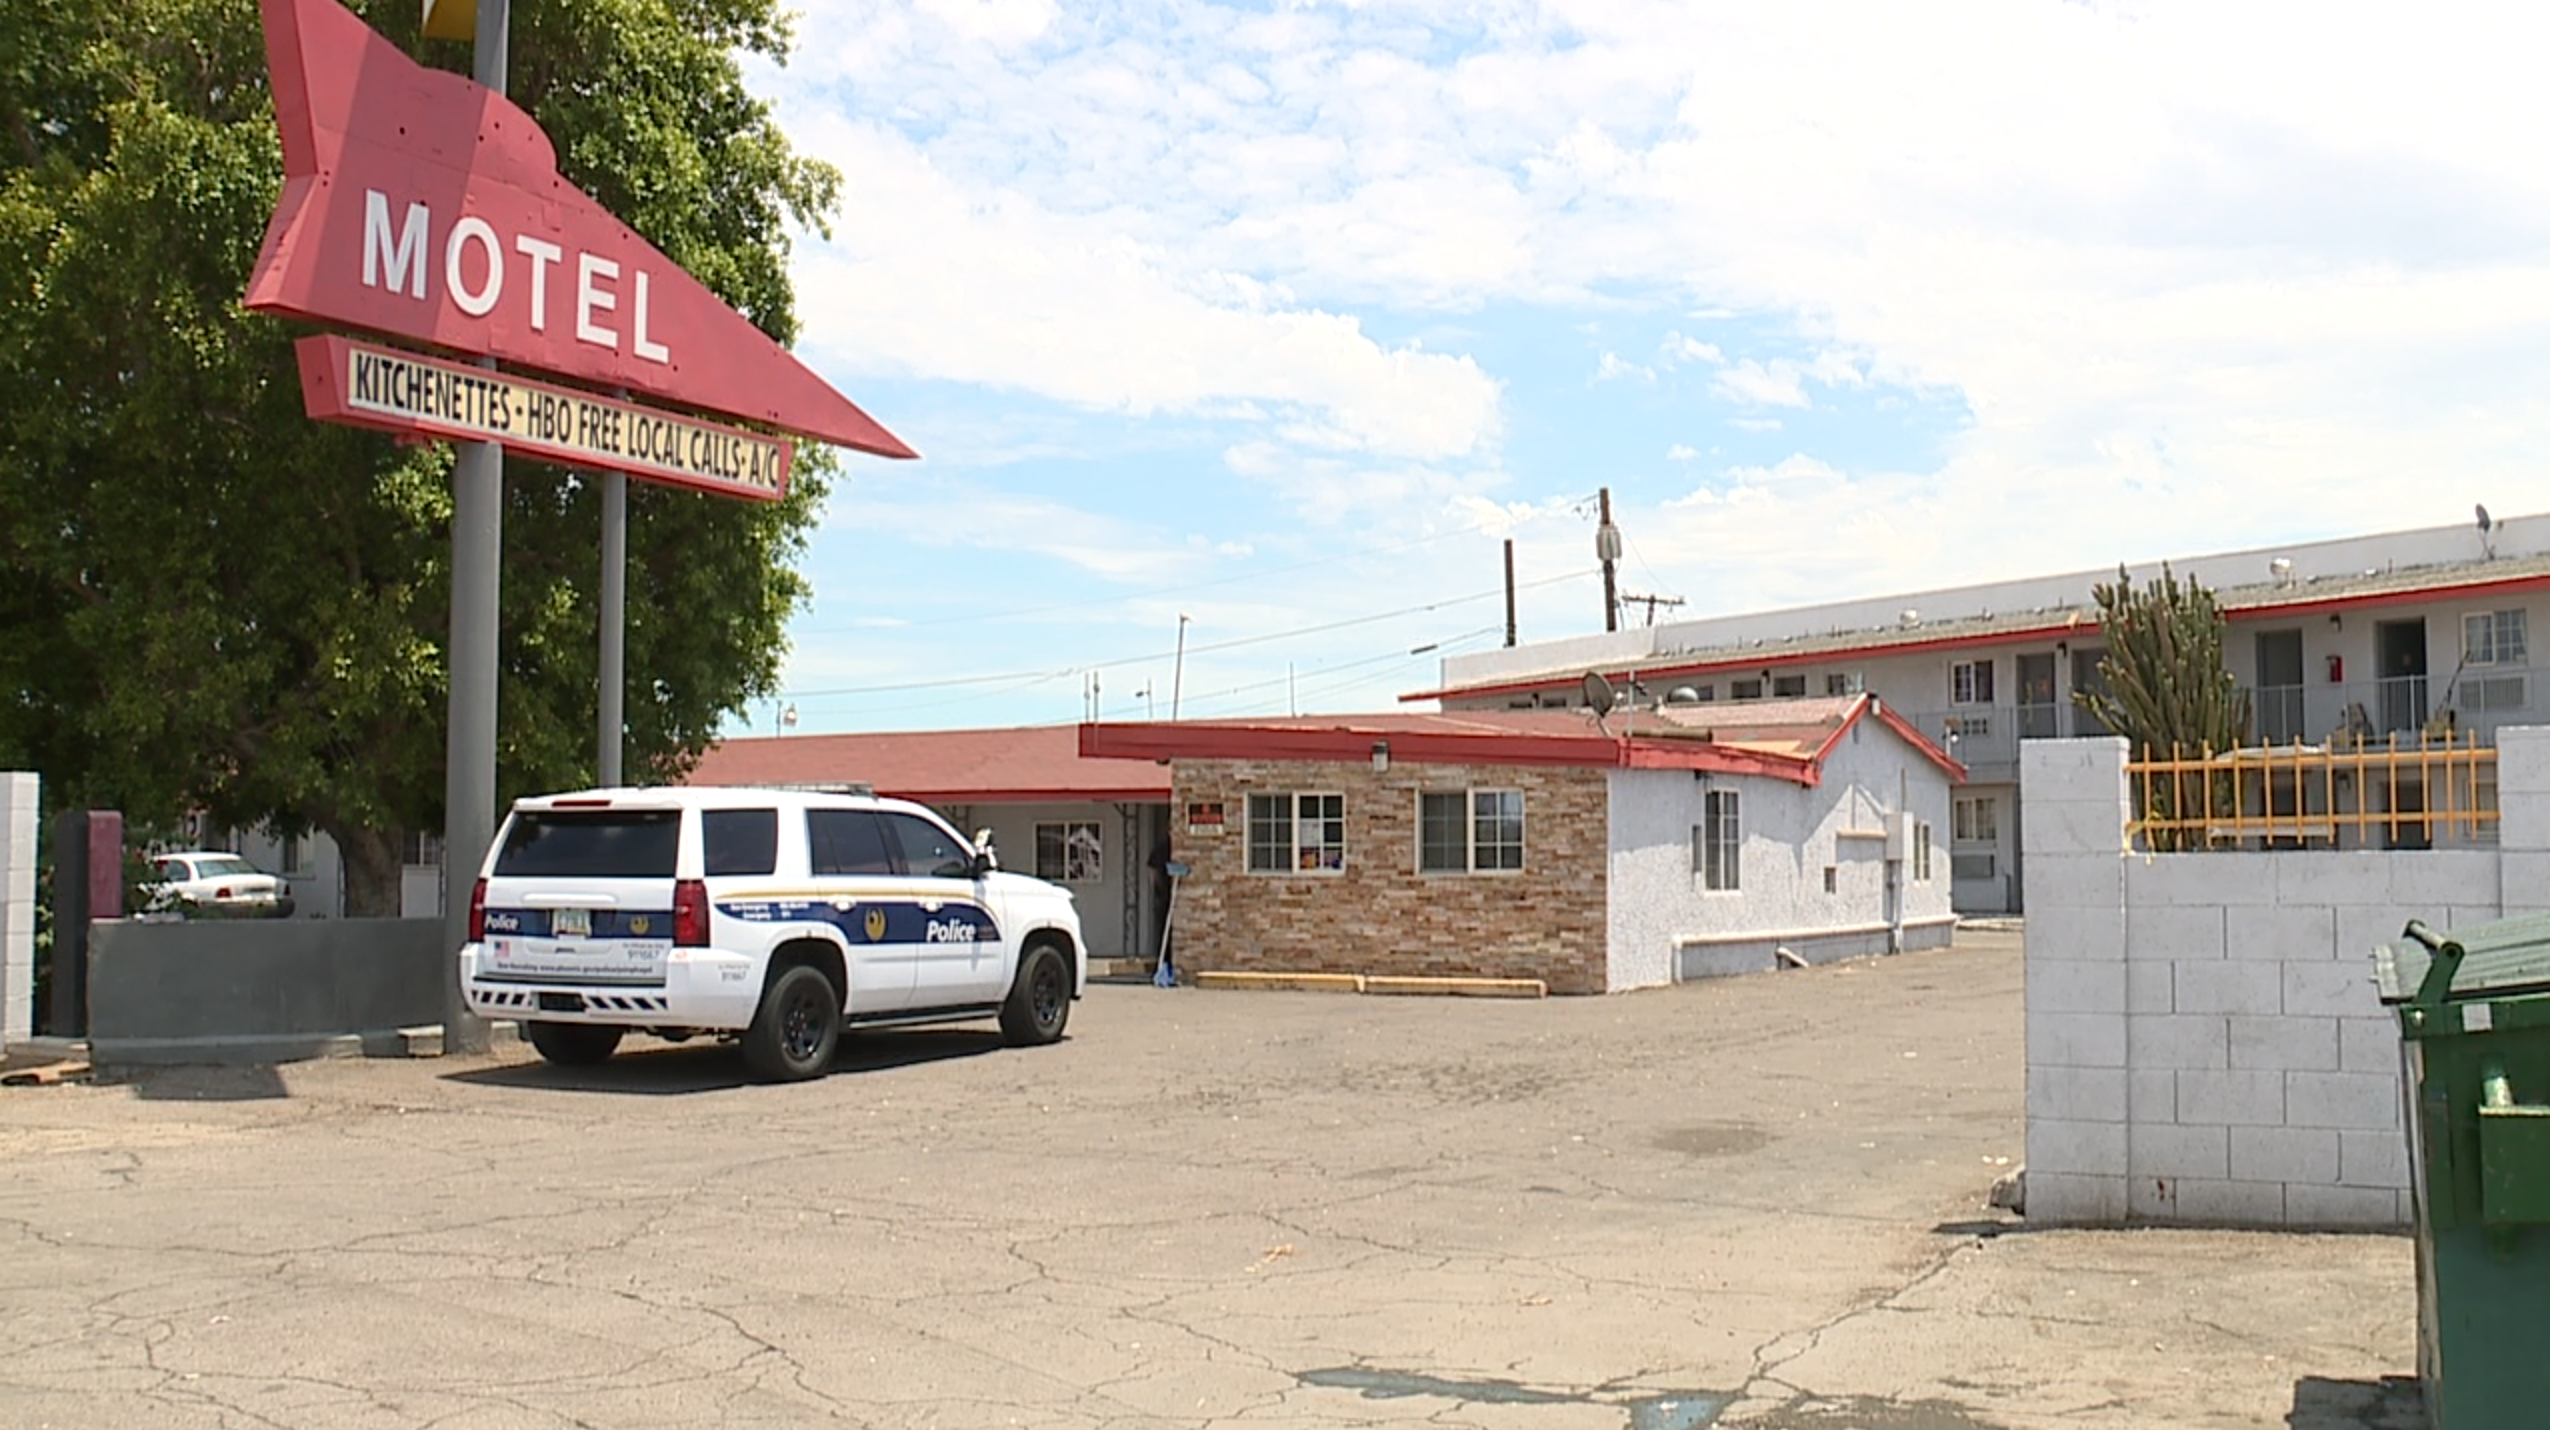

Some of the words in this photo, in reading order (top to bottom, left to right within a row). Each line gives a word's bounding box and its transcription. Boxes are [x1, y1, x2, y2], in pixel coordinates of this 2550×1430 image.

[362, 189, 669, 364] MOTEL
[527, 390, 572, 444] HBO
[579, 402, 622, 452] FREE
[627, 413, 685, 468] LOCAL
[750, 441, 779, 487] A/C
[484, 914, 519, 931] Police
[926, 917, 976, 943] Police
